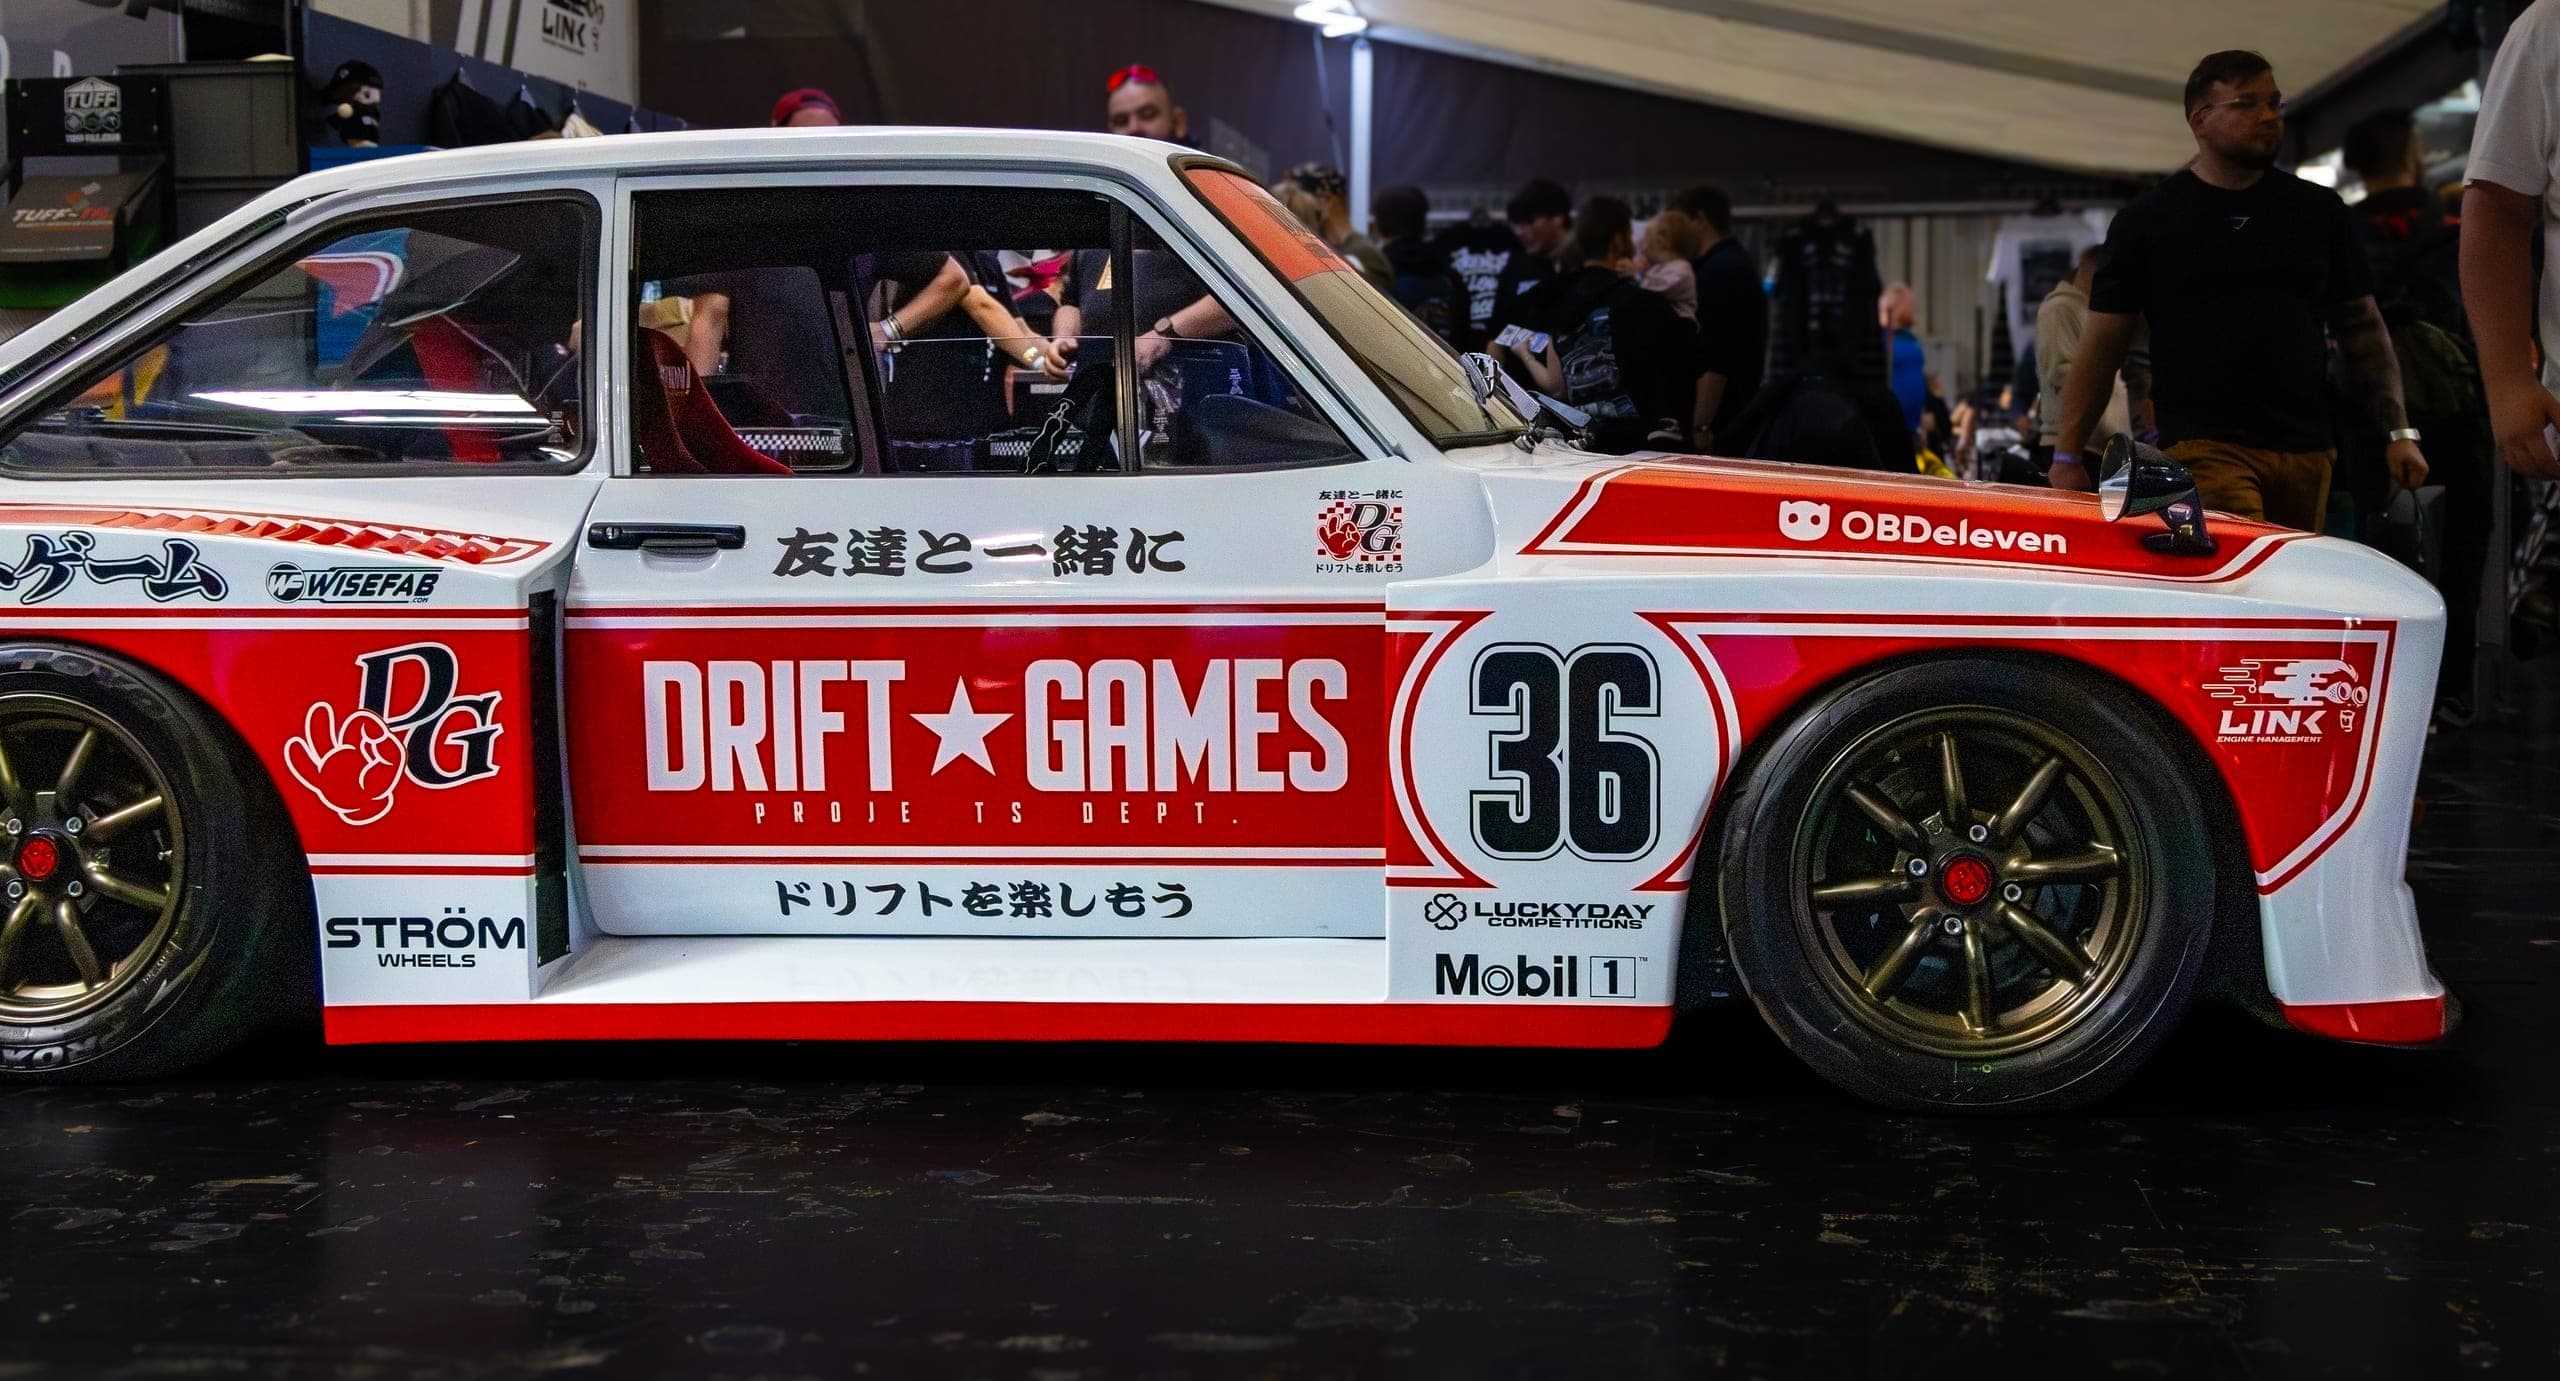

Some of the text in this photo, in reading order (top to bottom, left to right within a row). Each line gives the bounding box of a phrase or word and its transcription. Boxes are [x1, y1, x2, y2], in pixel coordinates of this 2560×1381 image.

[68, 91, 117, 109] TUFF
[772, 525, 1186, 577] 友達と一緒に
[1841, 511, 2067, 554] OBDeleven
[0, 531, 228, 605] ゲーム
[307, 573, 439, 597] WISEFAB
[643, 658, 1349, 792] DRIFT GAMES
[2218, 710, 2327, 735] LINK
[1470, 641, 1661, 863] 36
[1083, 801, 1238, 824] DEPT.
[774, 879, 1194, 919] ドリフトを楽しもう
[1474, 902, 1656, 920] LUCKYDAY
[326, 907, 526, 949] STRÖM
[1487, 917, 1643, 930] COMPETITIONS
[378, 953, 476, 968] WHEELS
[1435, 953, 1578, 997] Mobil
